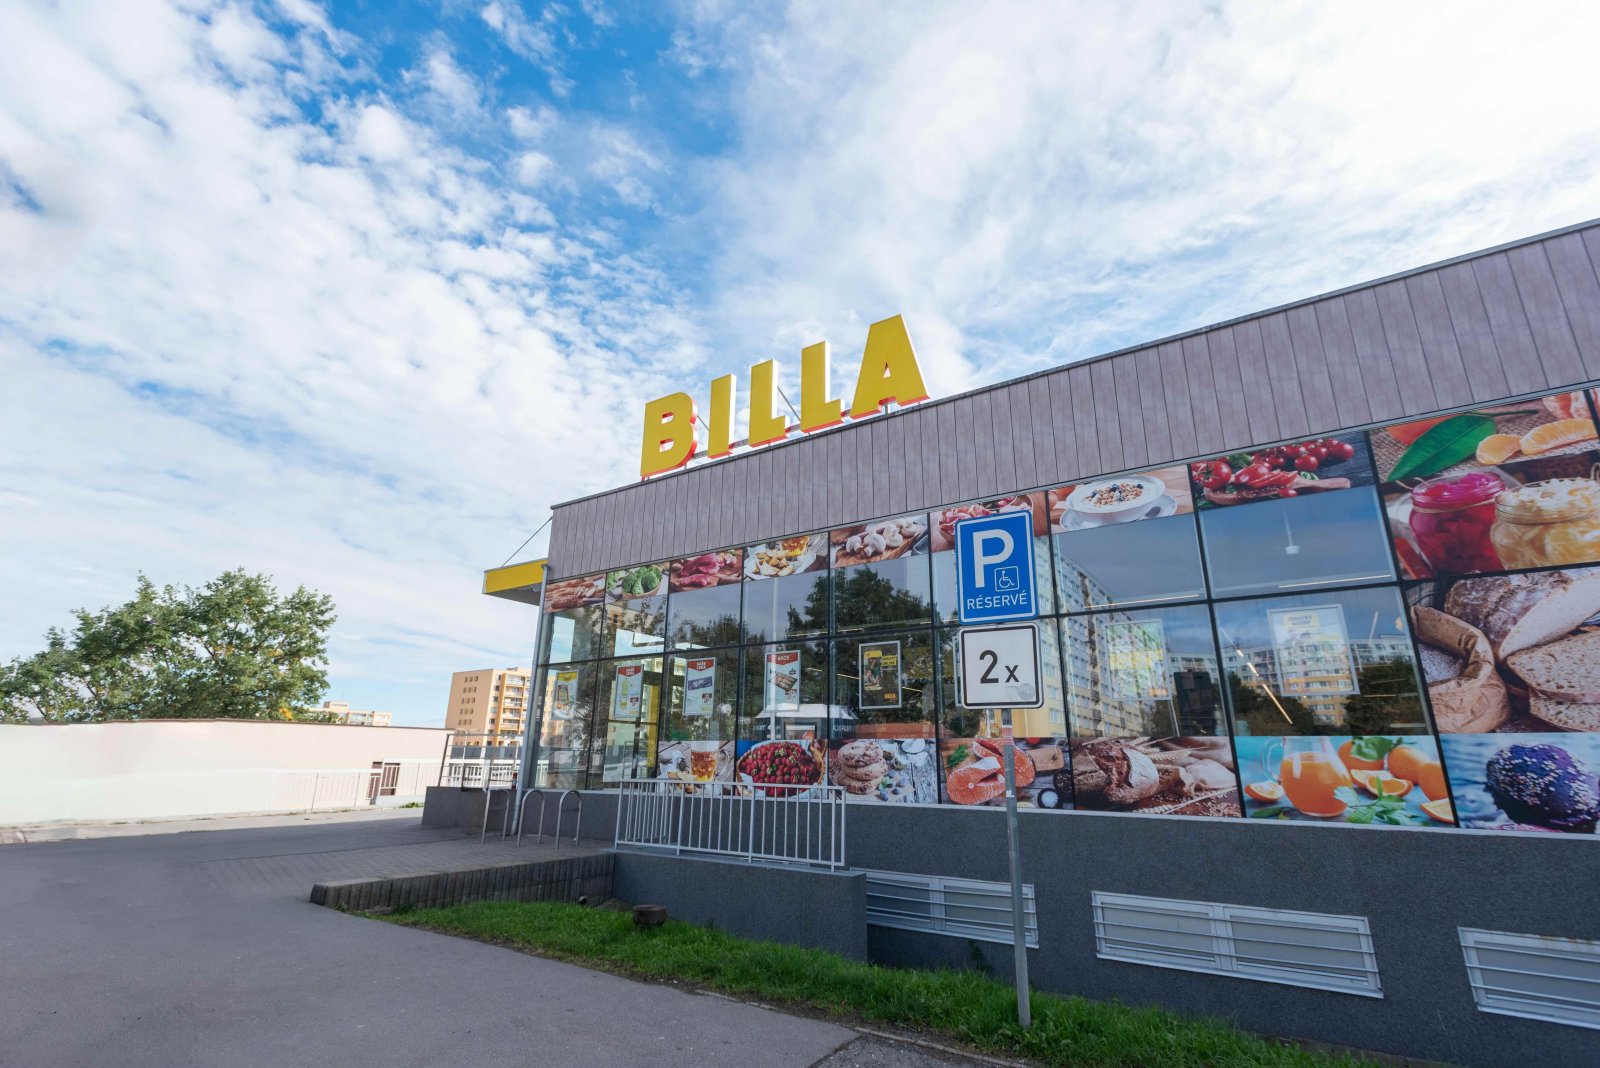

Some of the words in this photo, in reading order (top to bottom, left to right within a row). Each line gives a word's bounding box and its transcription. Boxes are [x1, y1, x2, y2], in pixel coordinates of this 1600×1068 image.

[640, 314, 930, 477] BILLA
[972, 528, 1015, 589] P
[967, 589, 1028, 610] RÉSERVÉ
